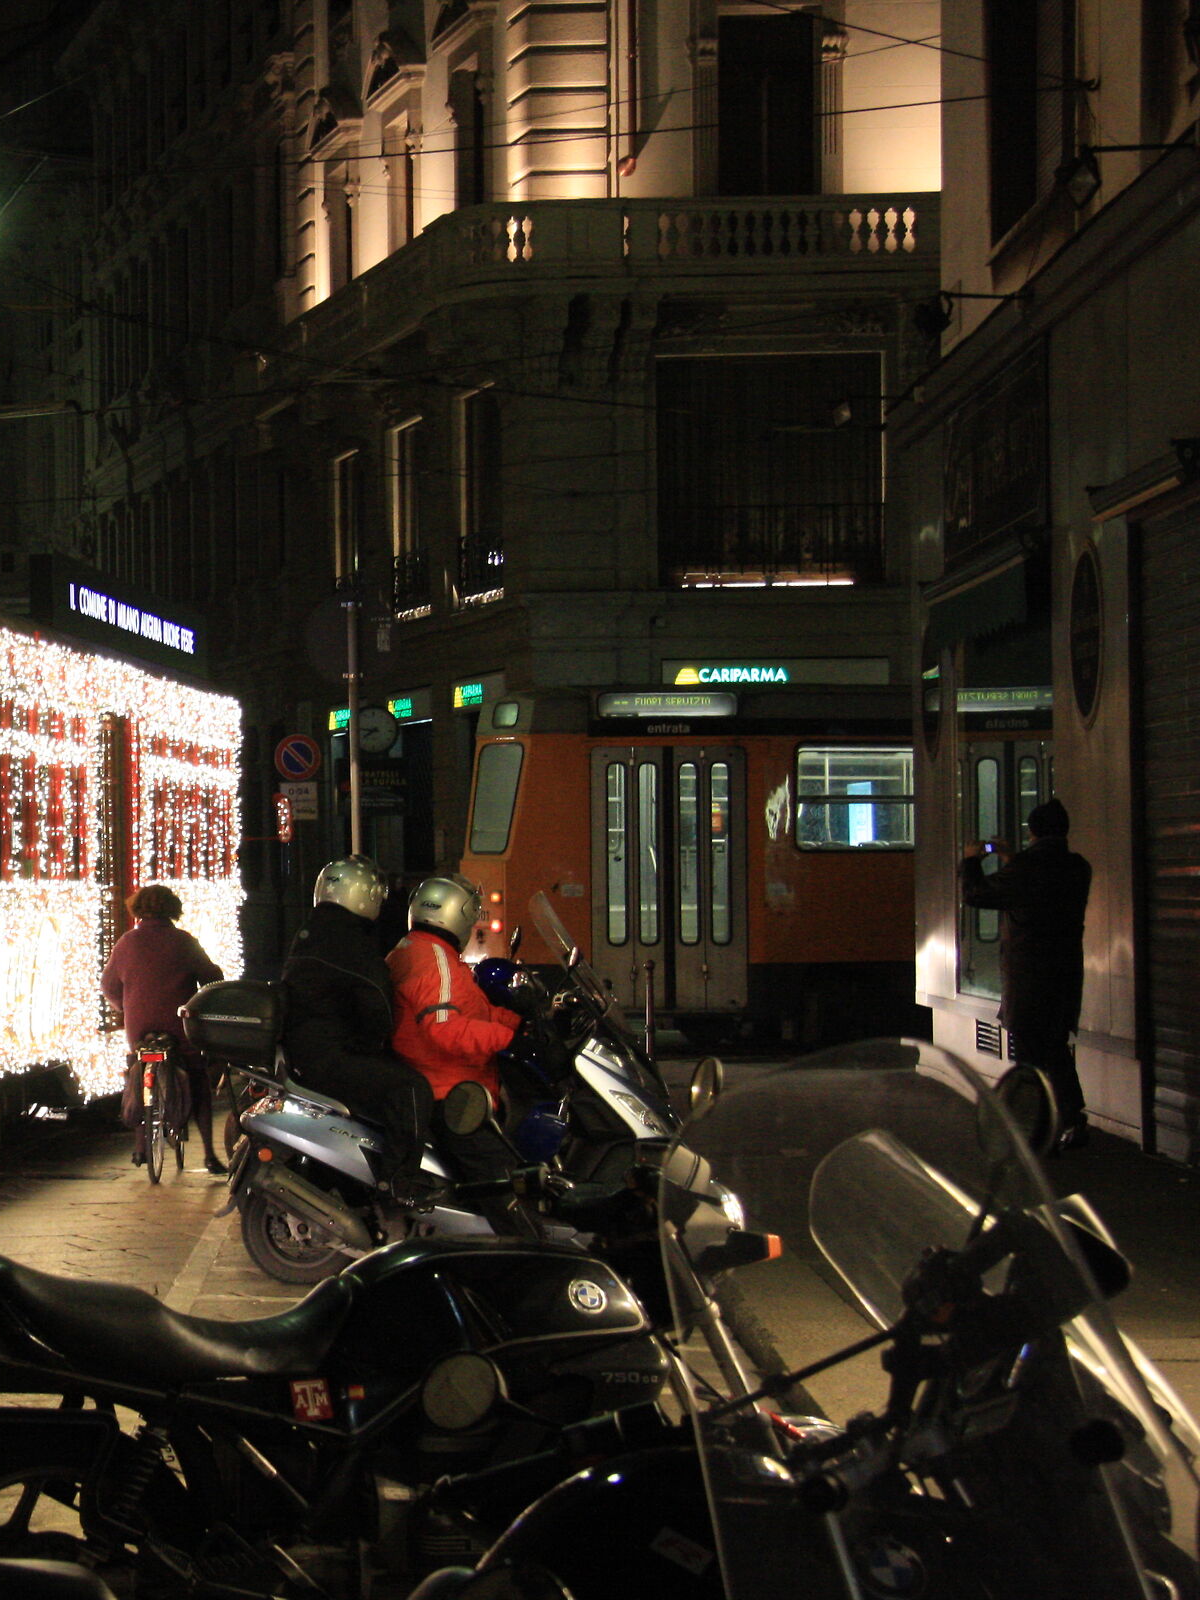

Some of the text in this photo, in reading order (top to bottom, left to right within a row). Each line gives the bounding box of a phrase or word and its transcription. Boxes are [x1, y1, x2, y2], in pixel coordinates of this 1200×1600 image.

[79, 586, 108, 622] COMUNE
[108, 597, 116, 626] DI
[116, 601, 140, 635] MILANO
[697, 666, 788, 683] CARIPARMA
[634, 696, 712, 706] FUORI SERVIZIO
[646, 723, 691, 734] entrata
